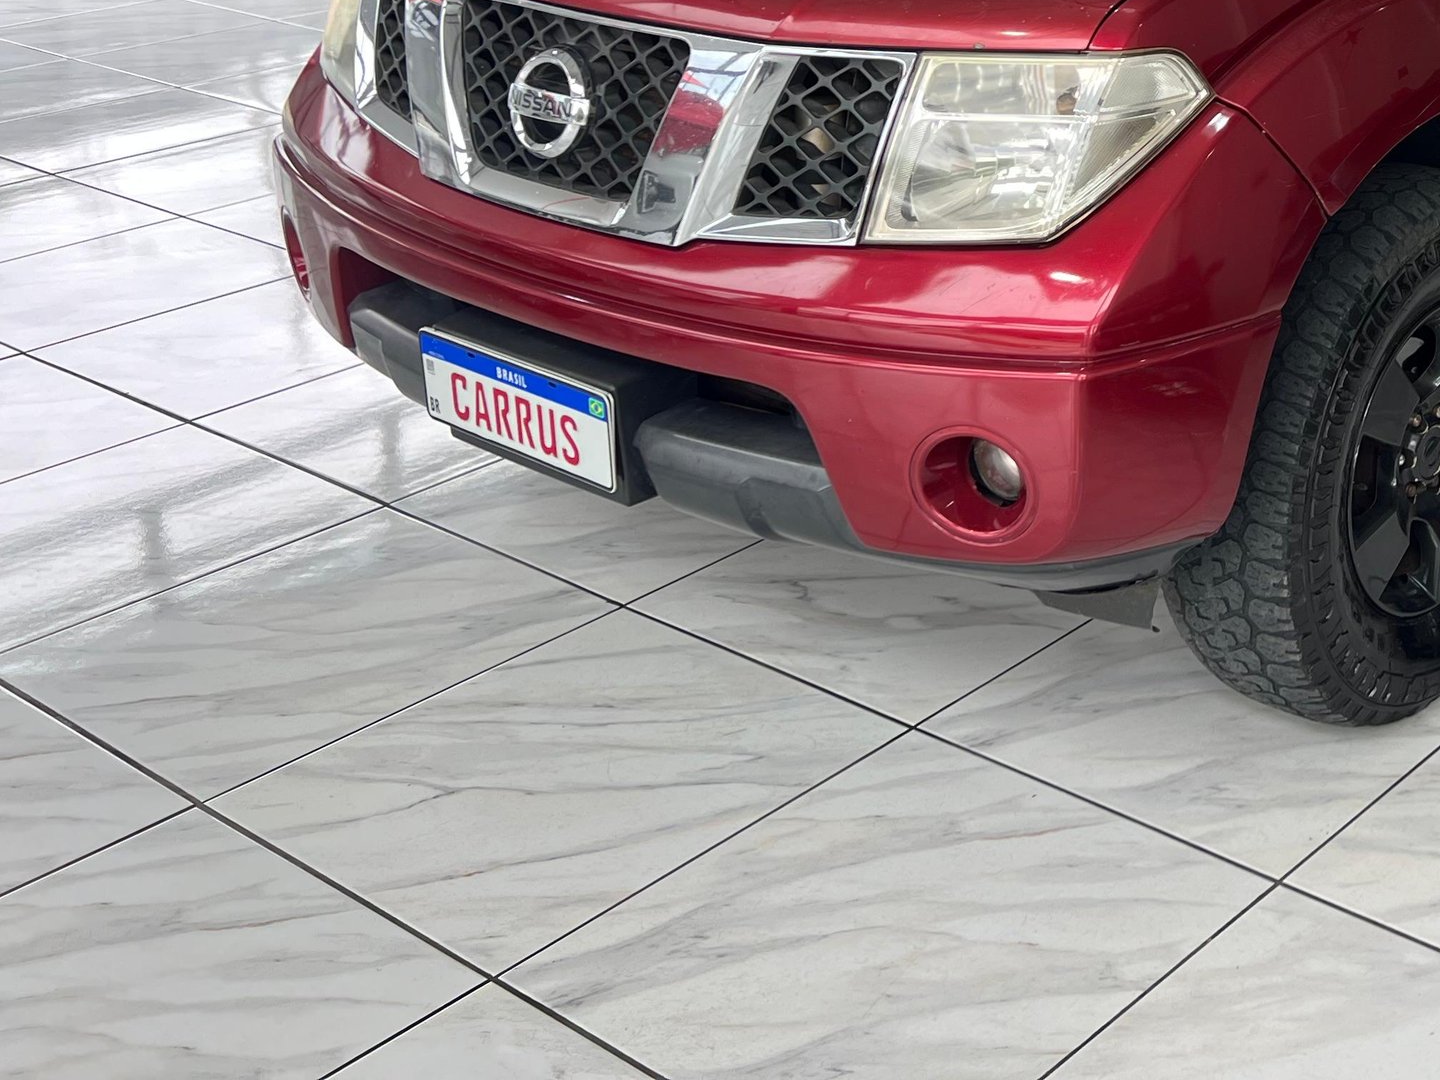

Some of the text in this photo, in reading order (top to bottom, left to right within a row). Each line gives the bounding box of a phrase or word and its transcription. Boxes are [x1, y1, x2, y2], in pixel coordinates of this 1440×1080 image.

[512, 85, 573, 118] NISSAN
[495, 366, 528, 389] BRASIL
[429, 396, 441, 414] BR
[451, 372, 580, 466] CARRUS
